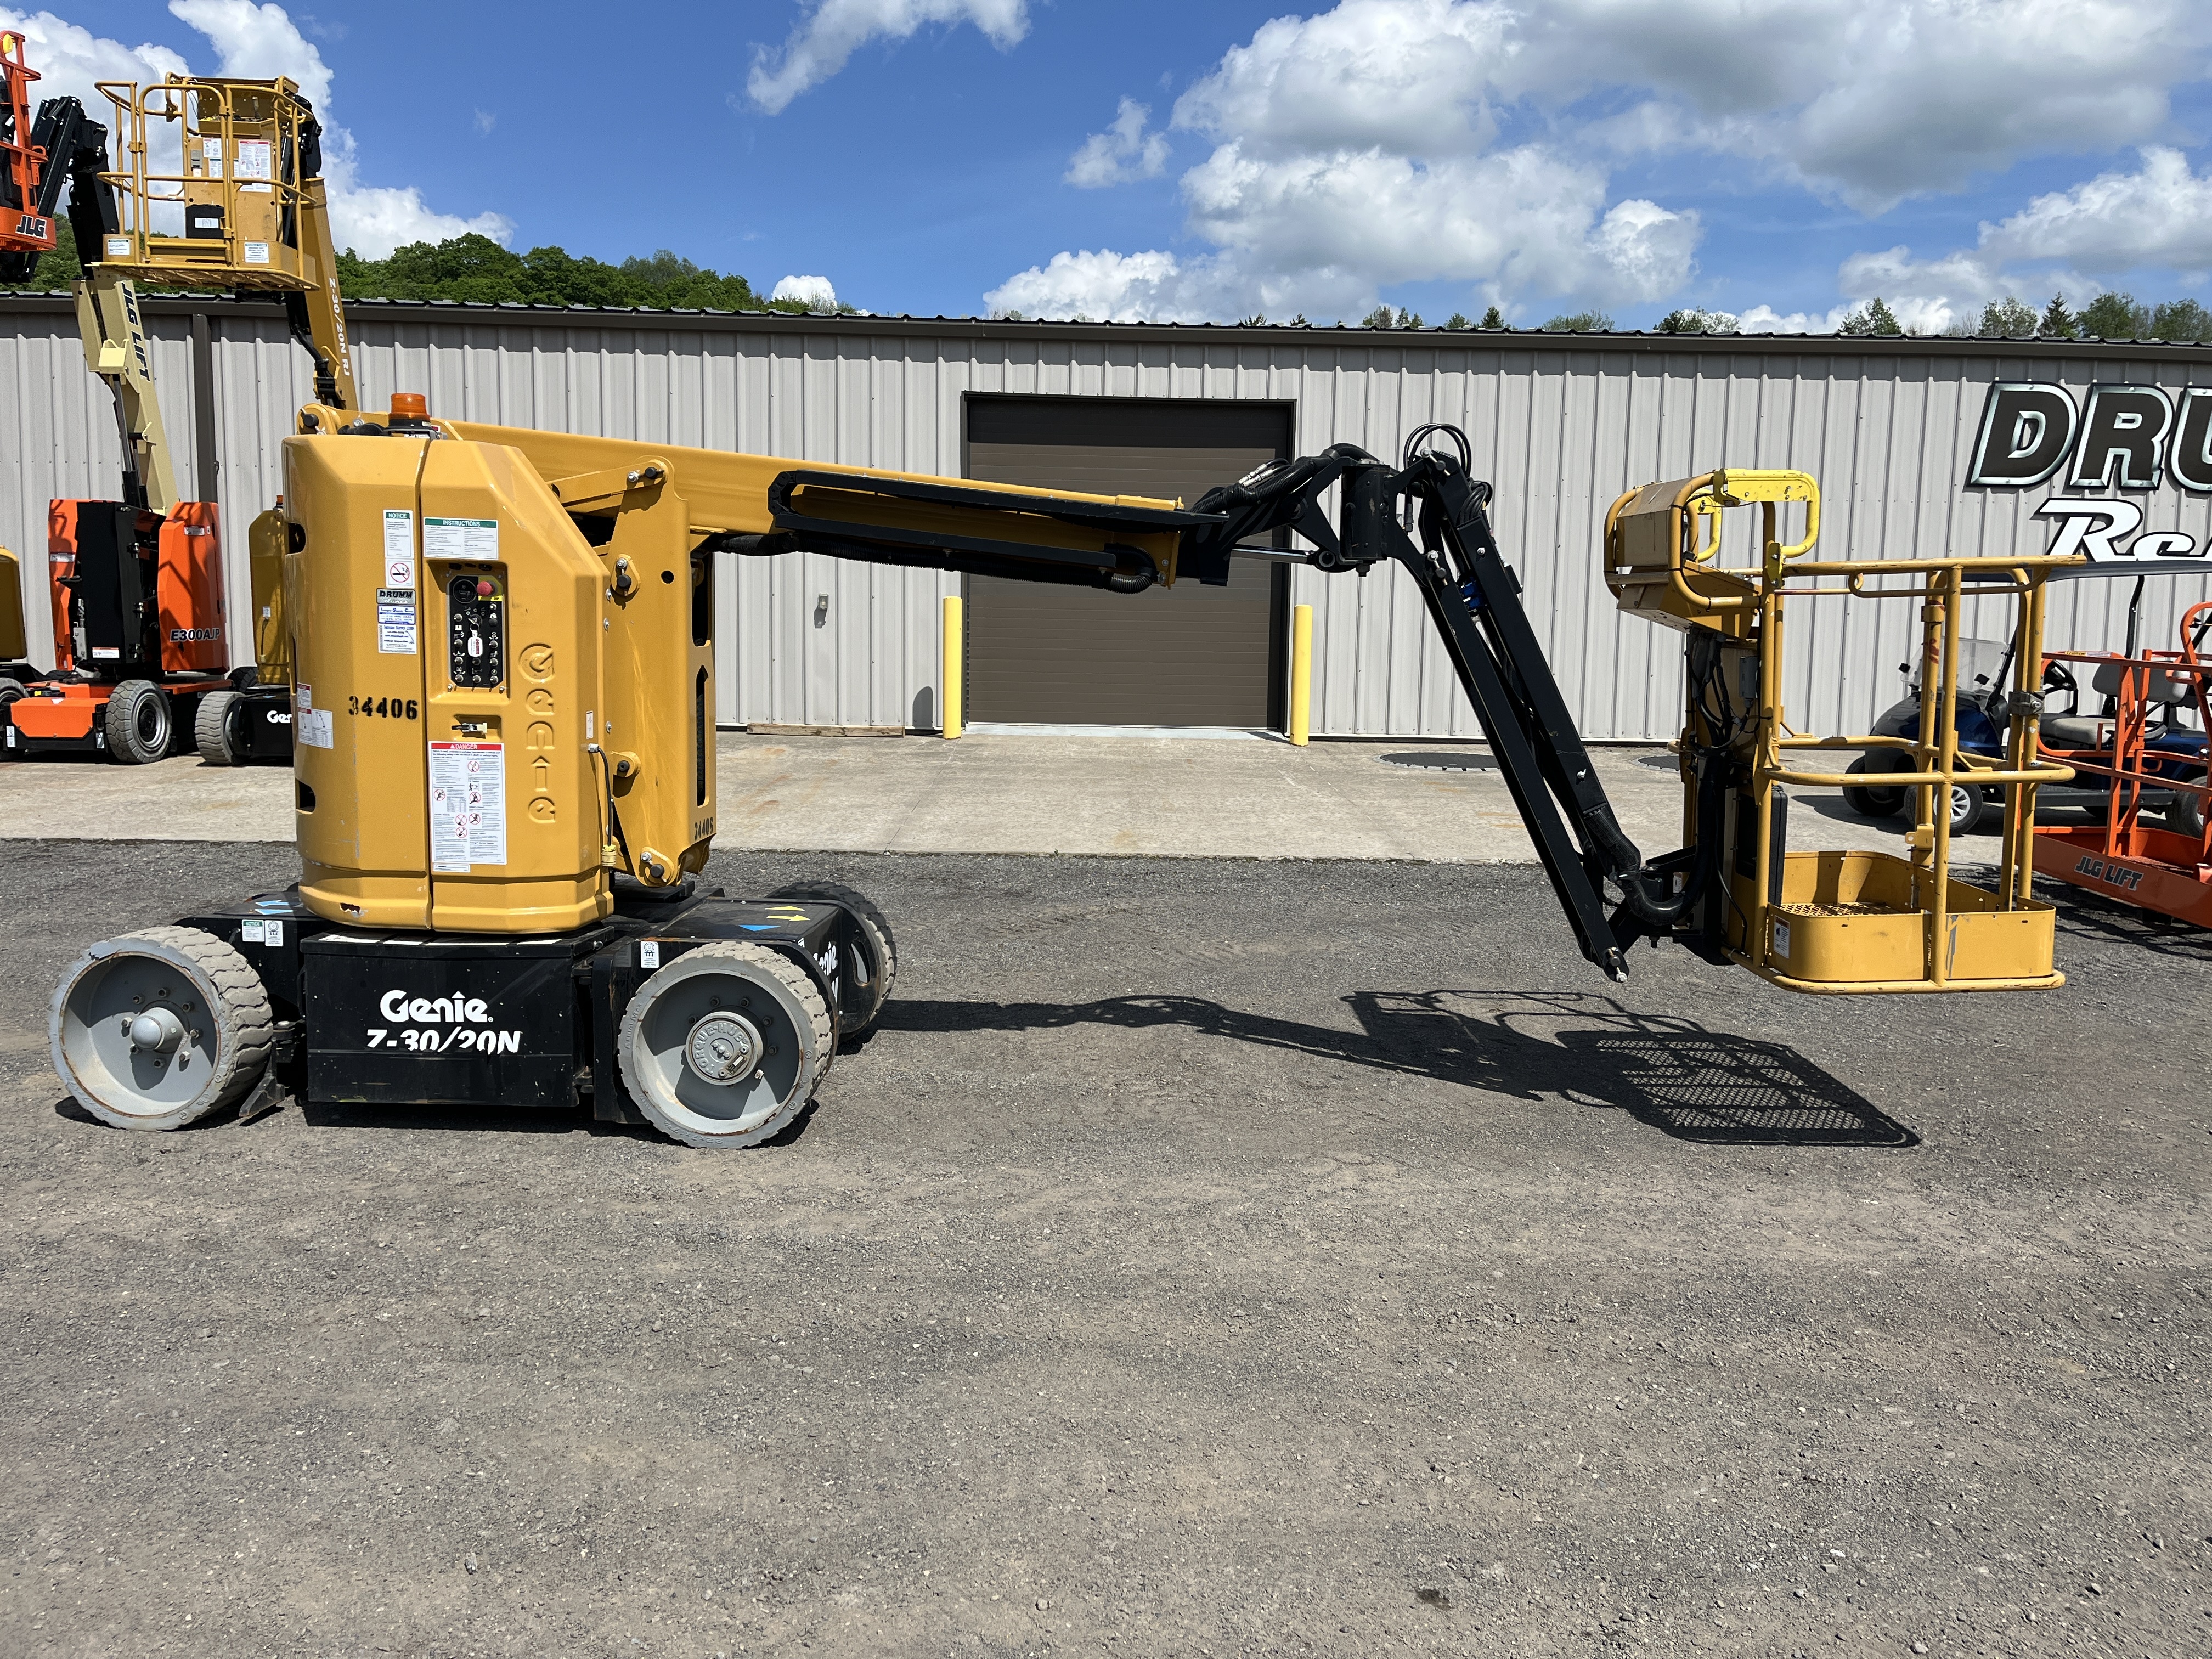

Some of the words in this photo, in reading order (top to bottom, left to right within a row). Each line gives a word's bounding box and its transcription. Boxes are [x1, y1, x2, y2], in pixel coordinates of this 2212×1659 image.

[15, 215, 47, 238] JLG
[121, 282, 139, 326] JLG
[131, 330, 151, 382] LIFT
[329, 277, 347, 354] Z-30/20N
[342, 358, 351, 376] RJ
[379, 590, 413, 599] DRUMM
[170, 628, 220, 642] E300AJP
[348, 695, 418, 720] 34406
[2074, 855, 2105, 879] JLG
[2103, 864, 2144, 891] LIFT
[380, 990, 490, 1023] Genie
